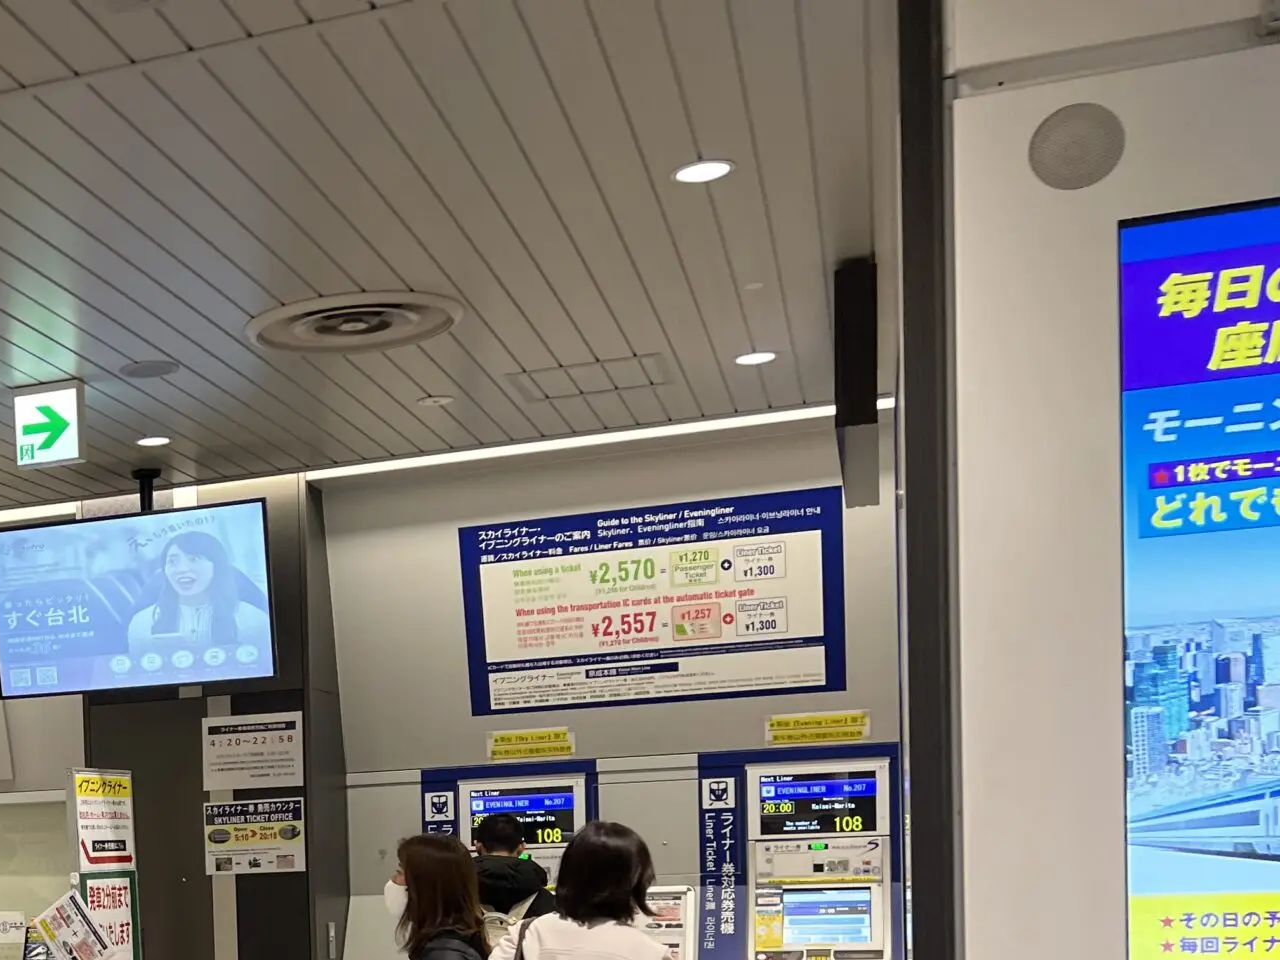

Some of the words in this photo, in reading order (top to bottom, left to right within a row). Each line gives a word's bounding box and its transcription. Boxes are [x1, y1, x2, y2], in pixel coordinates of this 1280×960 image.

[1173, 456, 1280, 482] 1枚でモー
[597, 518, 620, 528] Guide
[620, 517, 628, 525] to
[630, 516, 643, 524] the
[644, 509, 677, 523] Skyliner
[684, 506, 735, 519] Eveningliner
[805, 507, 821, 516] 안내
[479, 530, 591, 550] イブニングライナーのご案内
[569, 545, 588, 553] Fares
[593, 543, 612, 551] Liner
[613, 541, 633, 549] Fares
[736, 548, 757, 557] Liner
[758, 545, 782, 555] Ticket
[679, 550, 709, 563] ¥1,270
[512, 569, 533, 578] When
[534, 568, 553, 577] using
[560, 563, 581, 573] ticket
[589, 558, 656, 587] ¥2,570
[674, 563, 714, 573] Passenger
[743, 565, 775, 578] ¥1,300
[515, 608, 535, 617] When
[536, 607, 556, 617] using
[557, 605, 569, 613] the
[570, 600, 621, 613] transportation
[622, 598, 630, 607] IC
[631, 597, 652, 606] cards
[663, 595, 674, 603] the
[676, 592, 713, 602] automatic
[715, 589, 736, 599] ticket
[737, 588, 755, 597] gate
[738, 603, 759, 612] Liner
[760, 601, 784, 610] Ticket
[4, 605, 90, 630] すぐ台北
[681, 608, 712, 621] ¥1,257
[591, 611, 657, 639] ¥2,557
[745, 619, 777, 632] ¥1,300
[492, 674, 555, 685] イブニングライナー
[588, 669, 617, 678] 京成本線
[78, 780, 128, 795] イブニングライナー
[777, 785, 827, 796] EVENINGLINER
[843, 783, 866, 793] No.207
[206, 805, 255, 815] スカイライナー券
[485, 799, 530, 810] EVENINGLINER
[544, 798, 565, 806] No.207
[763, 802, 793, 814] 20:00
[214, 814, 245, 824] SKYLINER
[246, 813, 270, 823] TICKET
[270, 812, 294, 822] OFFICE
[834, 815, 863, 832] 108
[704, 812, 715, 839] Liner
[234, 833, 249, 842] 5:10
[536, 828, 562, 844] 108
[705, 843, 717, 871] Ticket
[720, 812, 736, 935] ライナー券対応券売機
[88, 885, 130, 912] 発車2分前まで
[703, 916, 716, 949] 라이너권
